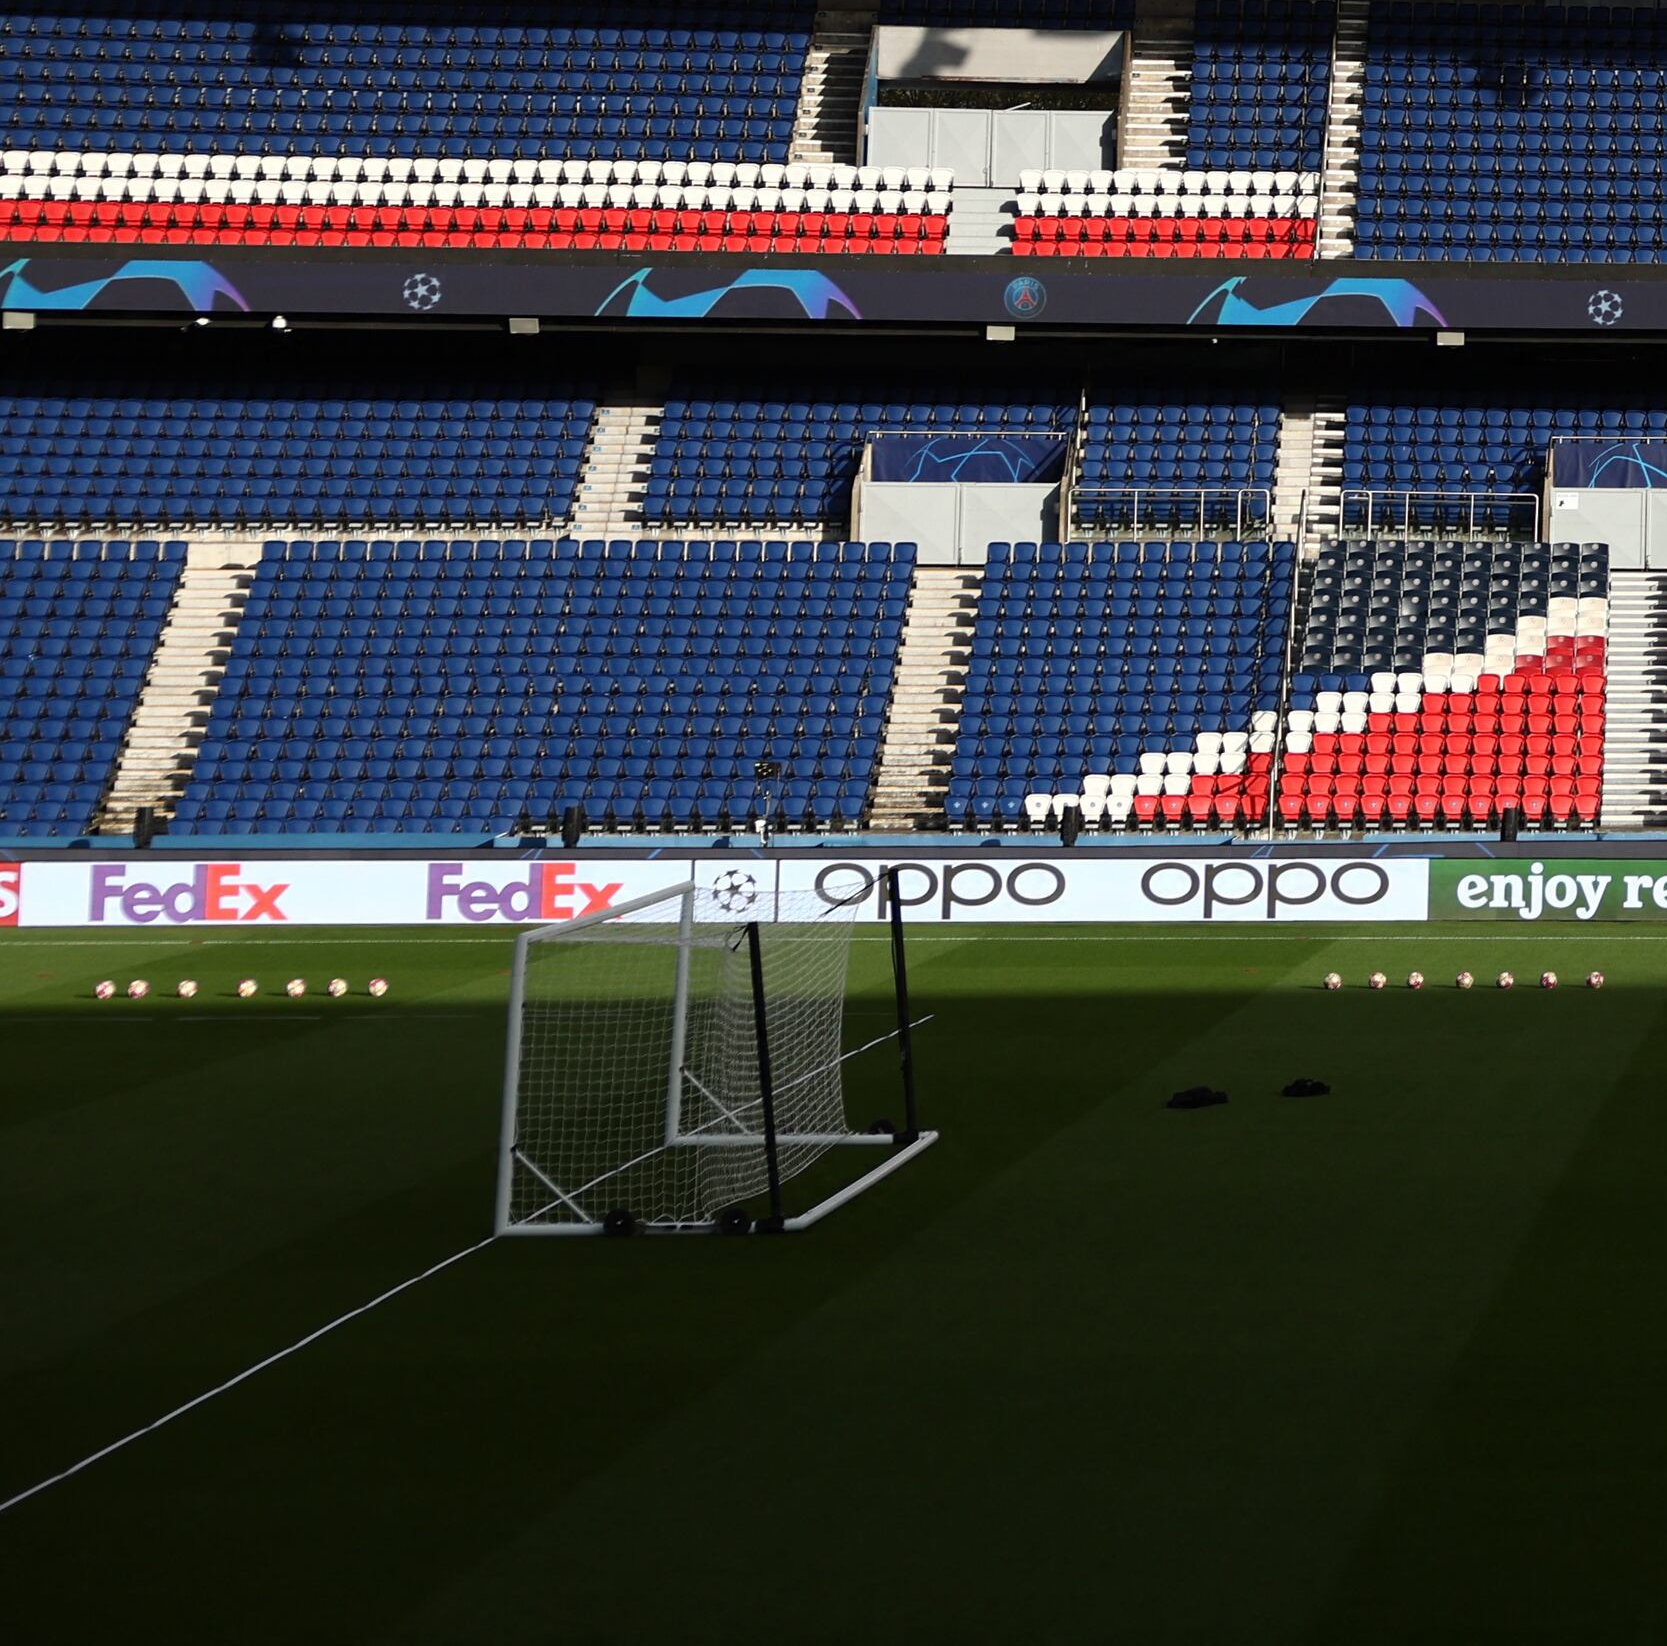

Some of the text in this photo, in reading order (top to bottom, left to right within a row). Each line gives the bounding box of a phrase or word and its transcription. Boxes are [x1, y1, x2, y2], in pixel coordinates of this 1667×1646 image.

[90, 863, 289, 924] FedEx
[426, 863, 624, 922] FedEx
[814, 862, 1066, 920] oppo
[1140, 861, 1390, 919] oppo
[1456, 861, 1612, 920] enjoy
